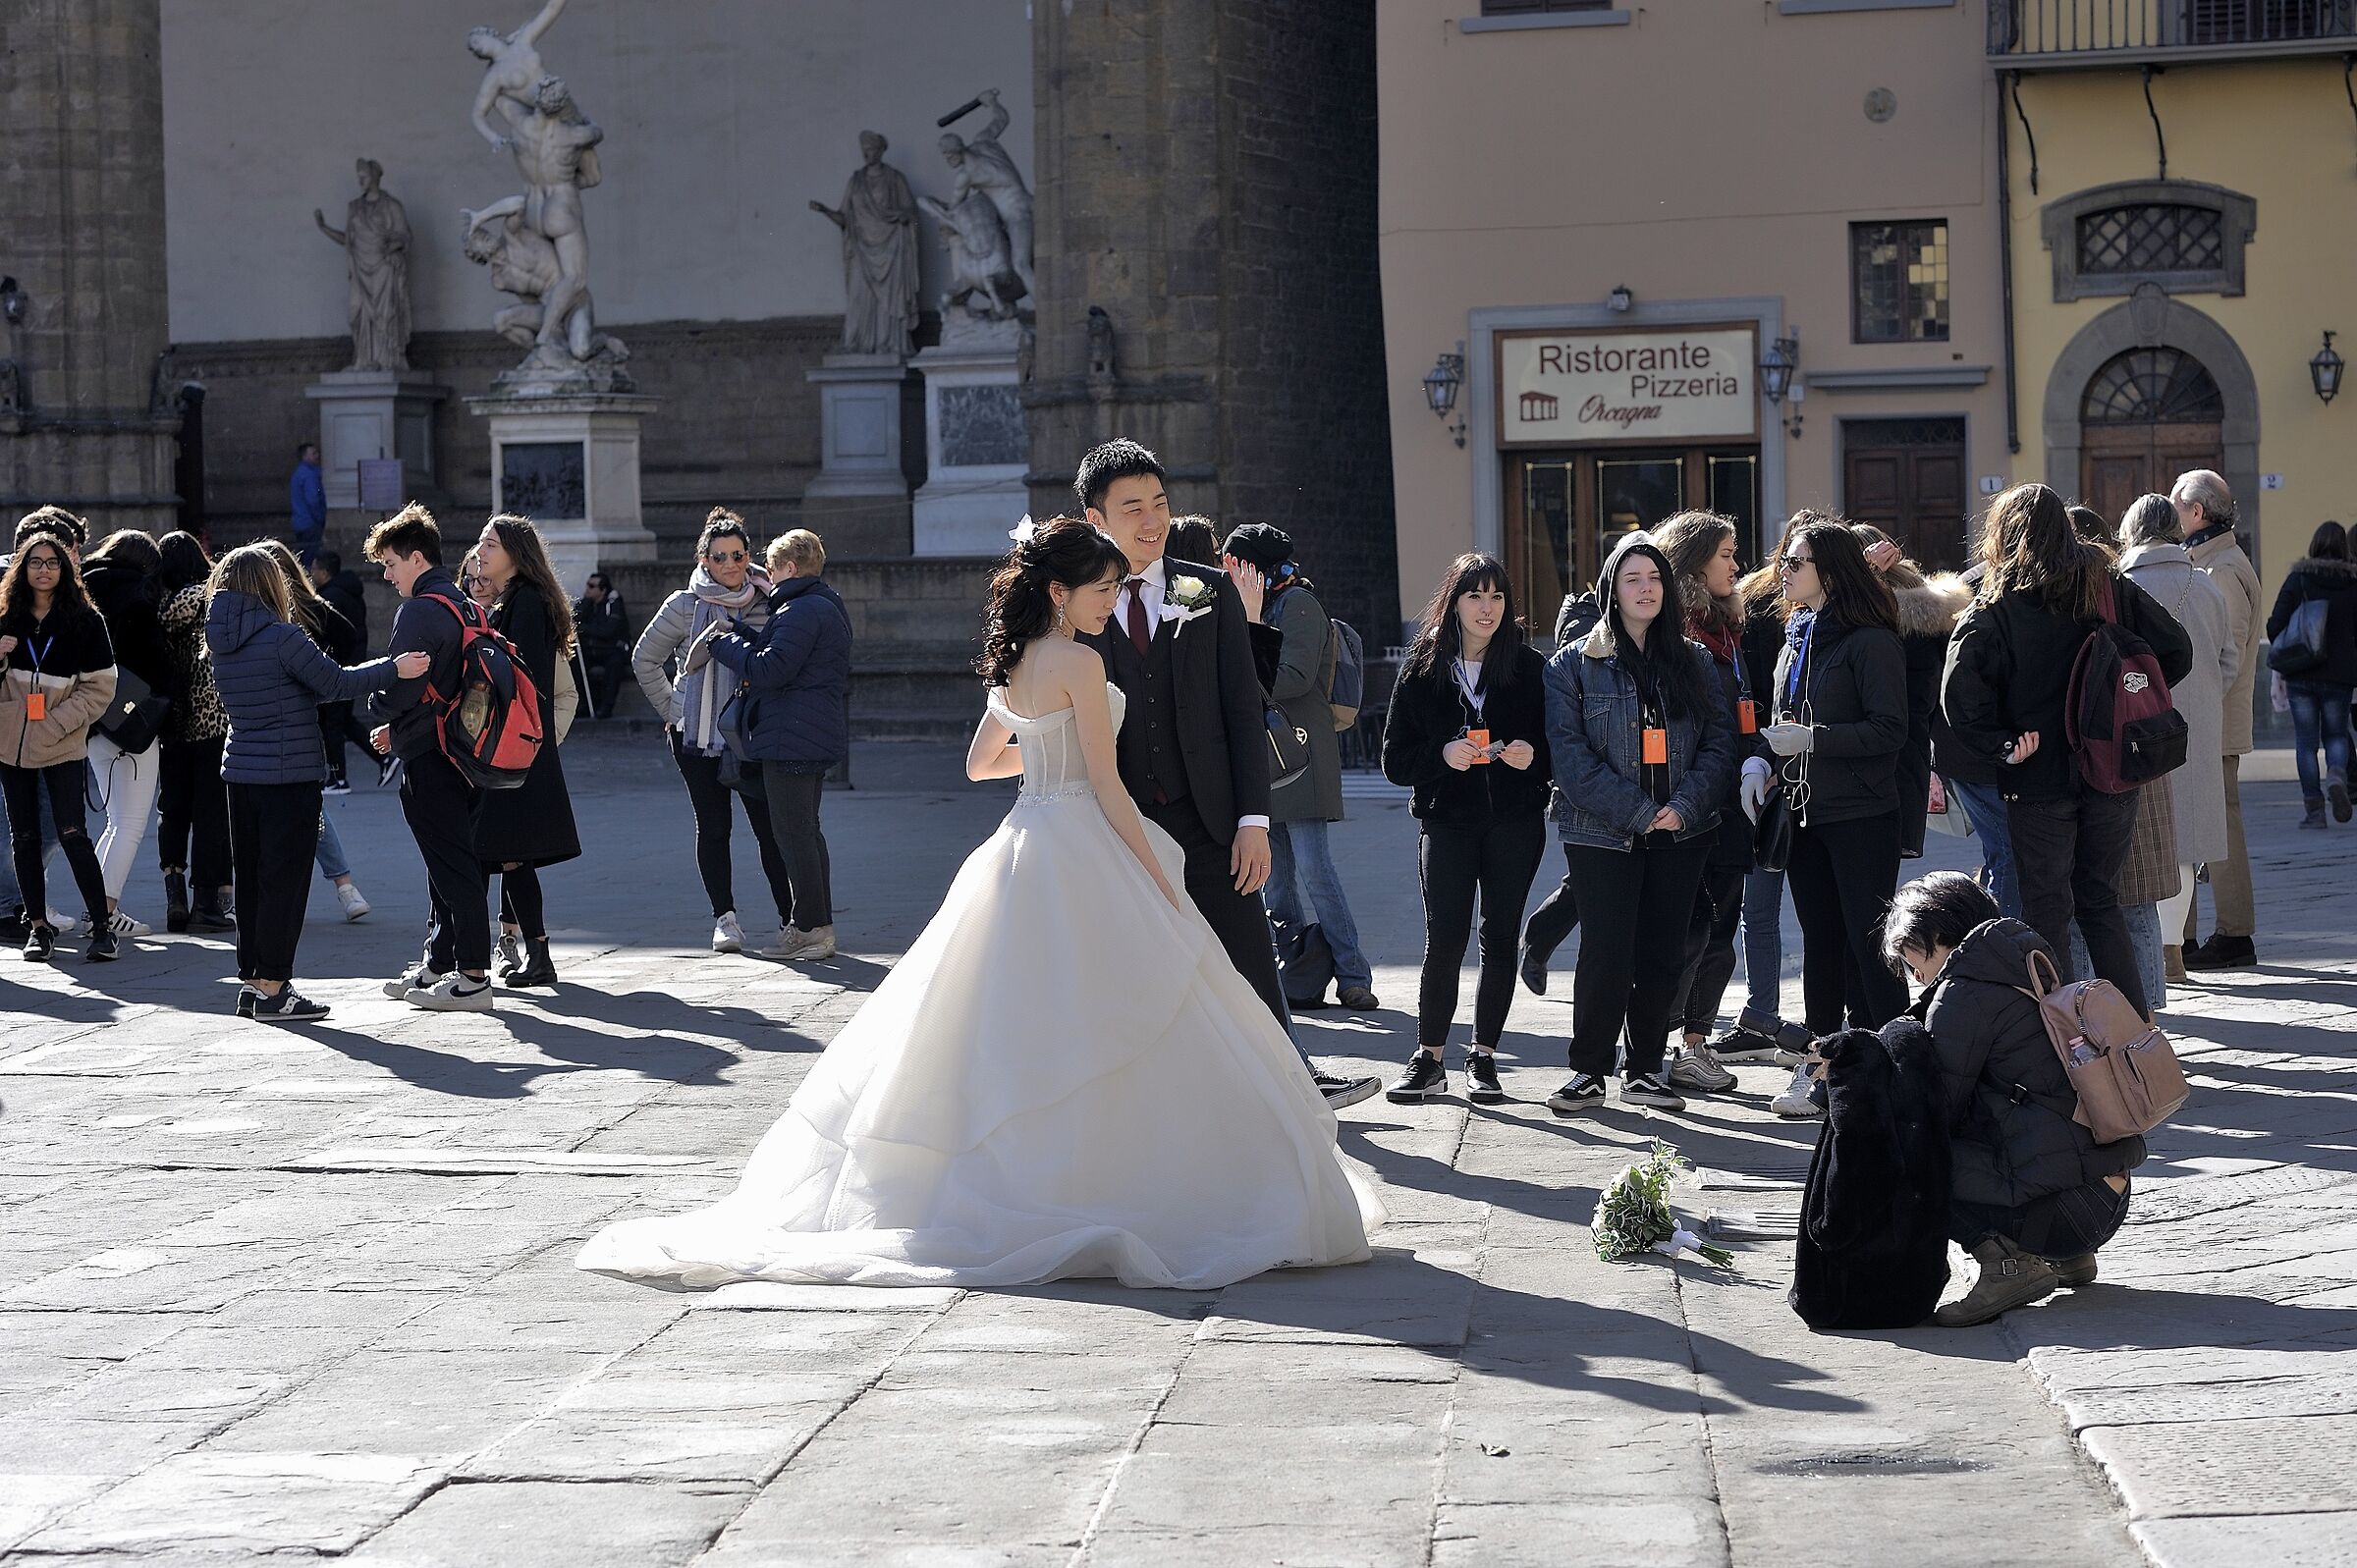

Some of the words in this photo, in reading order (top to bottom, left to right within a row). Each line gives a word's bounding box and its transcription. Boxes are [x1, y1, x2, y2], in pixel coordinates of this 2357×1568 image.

[1539, 341, 1711, 375] Ristorante
[1630, 372, 1738, 399] Pizzeria
[1578, 394, 1662, 429] Orcagna
[2267, 473, 2276, 489] 2
